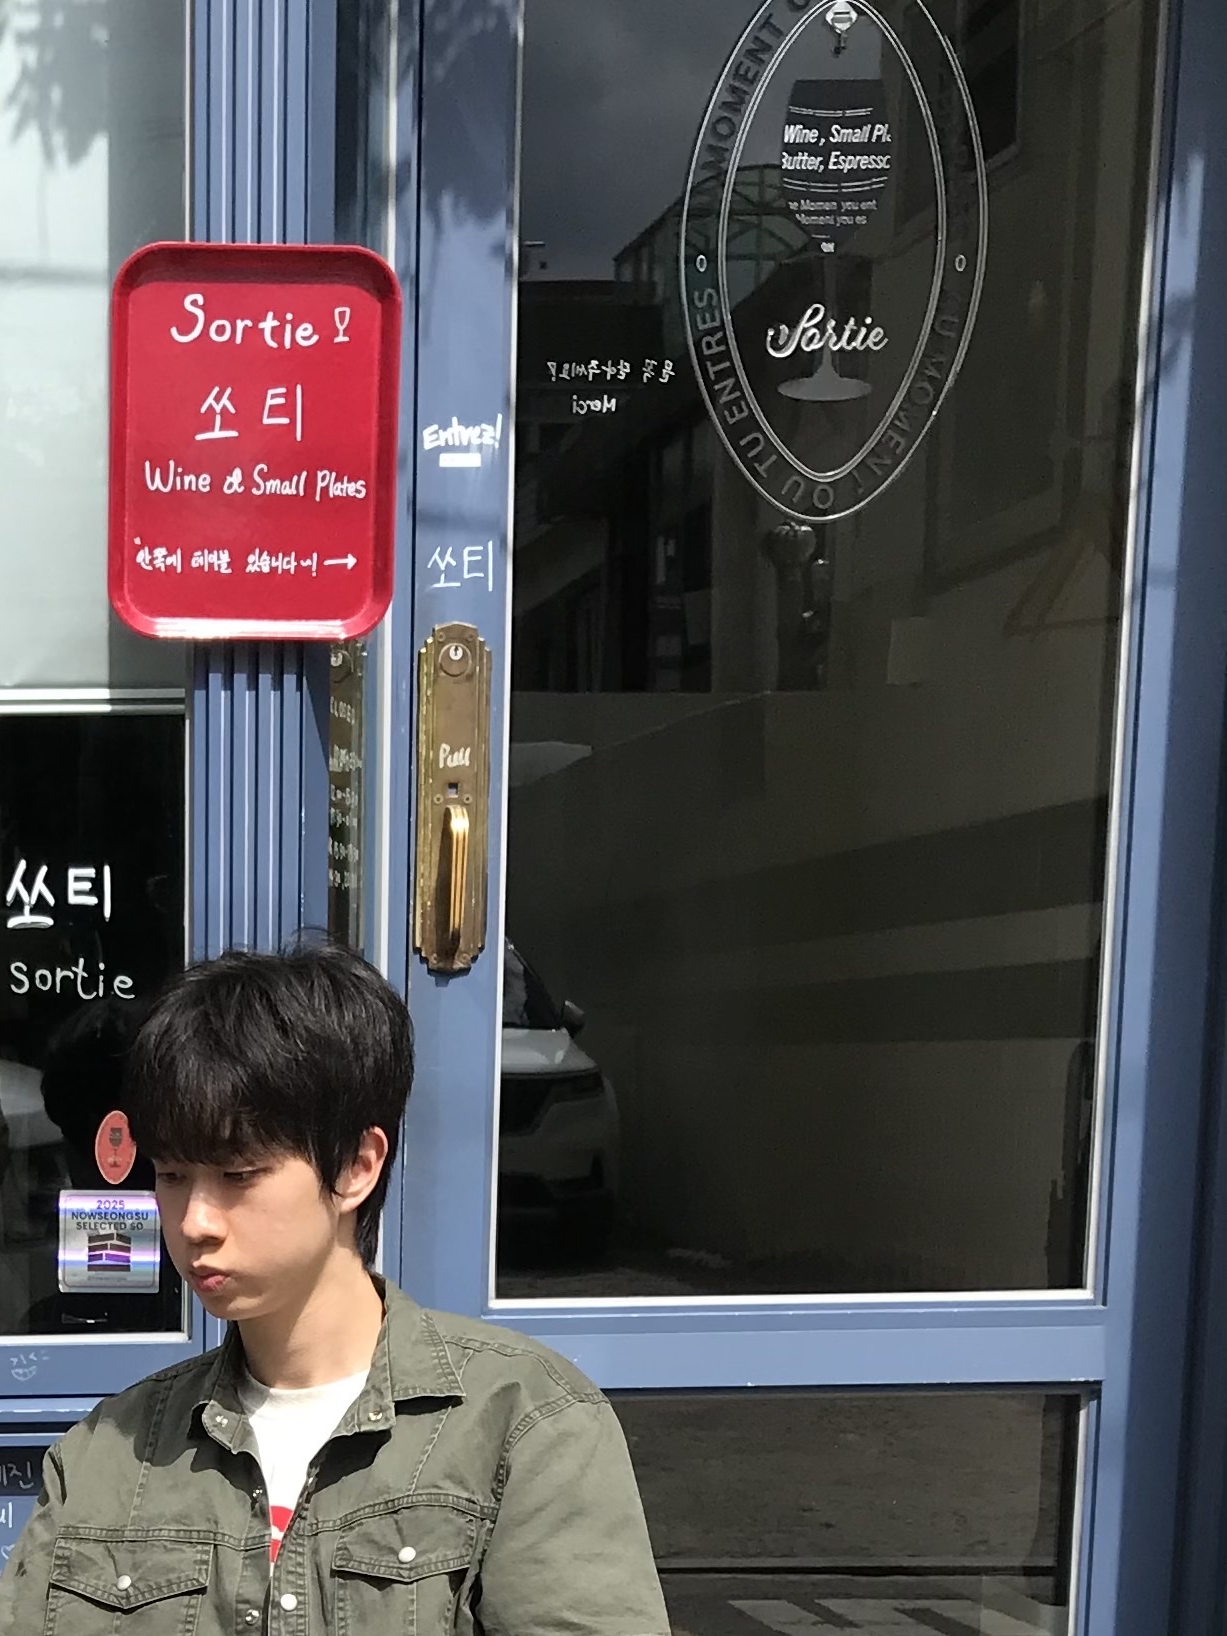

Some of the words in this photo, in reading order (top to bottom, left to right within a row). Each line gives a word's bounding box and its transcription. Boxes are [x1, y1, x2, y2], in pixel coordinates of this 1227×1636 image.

[829, 123, 871, 143] Small
[171, 293, 321, 350] Sortie
[766, 303, 889, 358] Sortie
[695, 286, 751, 428] ENTRES
[422, 412, 504, 451] Entrez!
[144, 460, 211, 493] Wine
[251, 463, 307, 498] Small
[315, 470, 367, 502] Plates
[191, 548, 233, 575] 테이블
[427, 540, 494, 592] 쏘티
[438, 743, 471, 769] Pull
[5, 858, 112, 930] 쏘티
[71, 1211, 149, 1221] NOWSEONGSU
[96, 1199, 126, 1211] 2025
[76, 1221, 128, 1231] SELECTED
